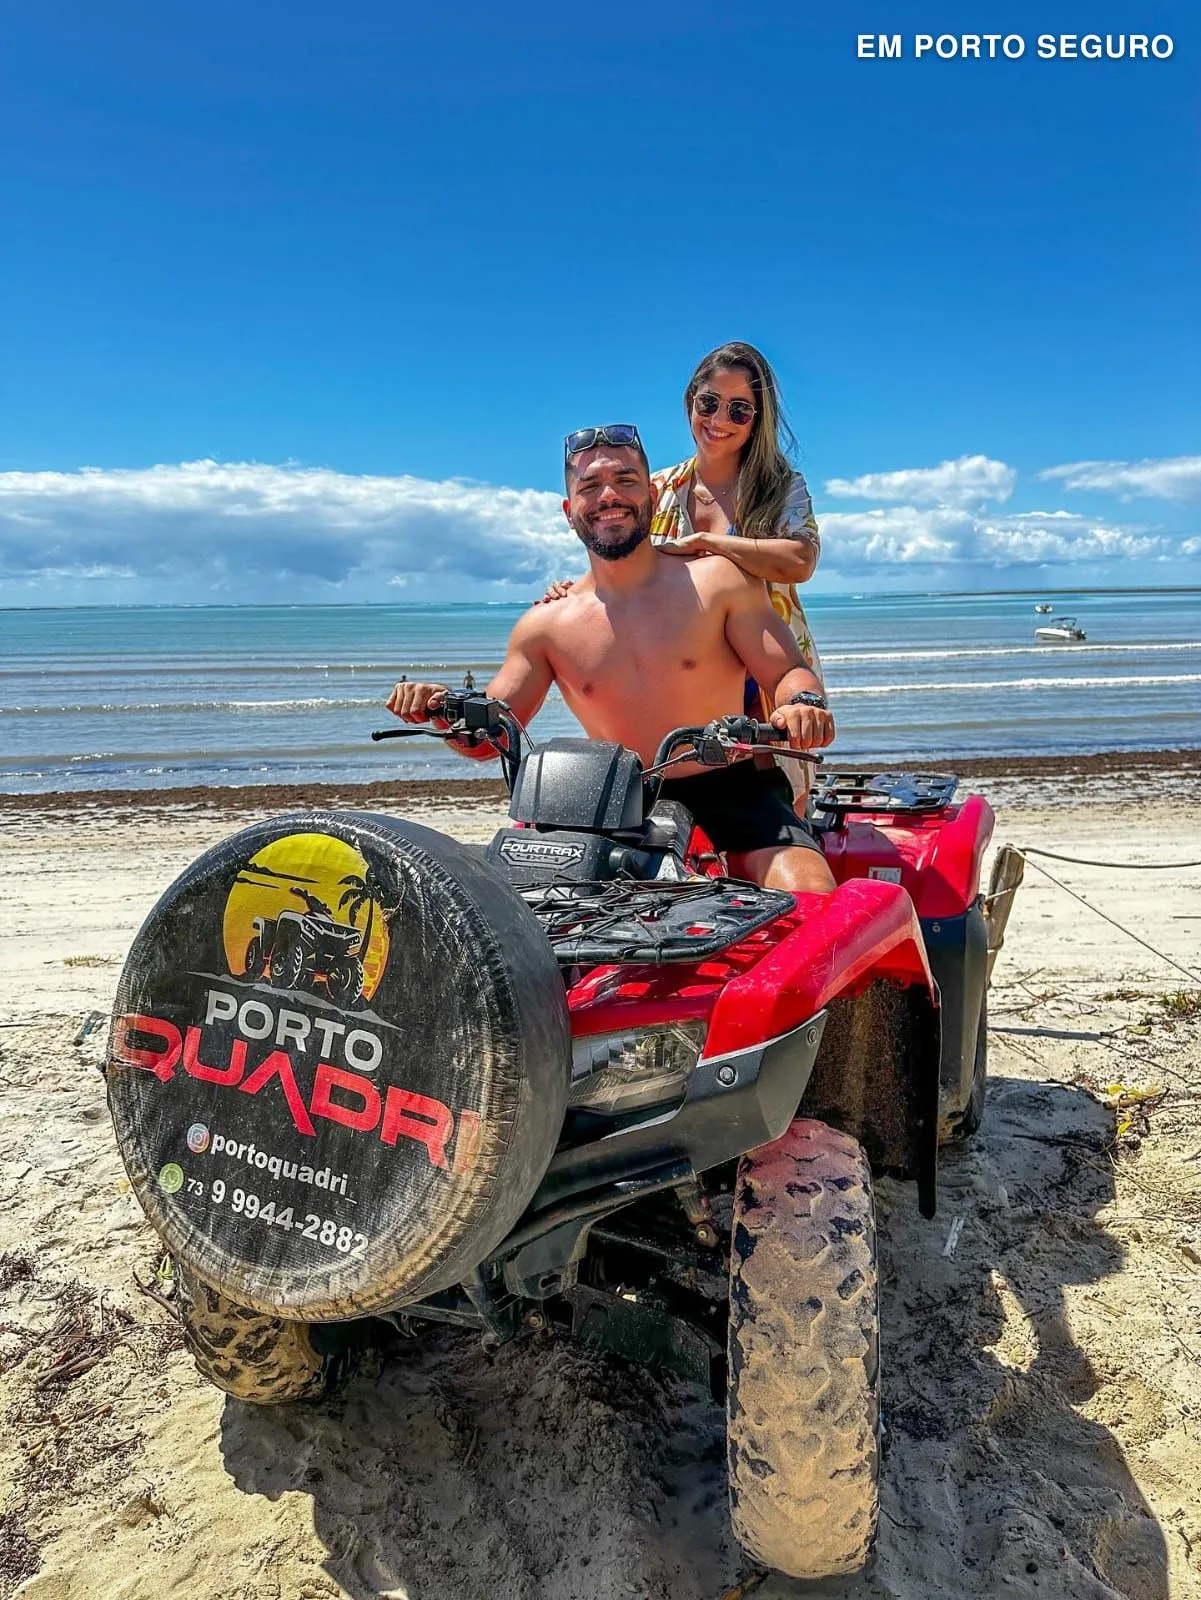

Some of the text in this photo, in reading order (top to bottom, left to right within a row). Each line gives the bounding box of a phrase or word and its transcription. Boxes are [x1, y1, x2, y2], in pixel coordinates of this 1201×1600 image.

[500, 842, 584, 858] FOURTRAX
[204, 989, 384, 1072] PORTO
[113, 1013, 481, 1177] QUADRI
[210, 1133, 358, 1205] portoquadri_
[187, 1178, 370, 1259] 73 9 9944-2882
